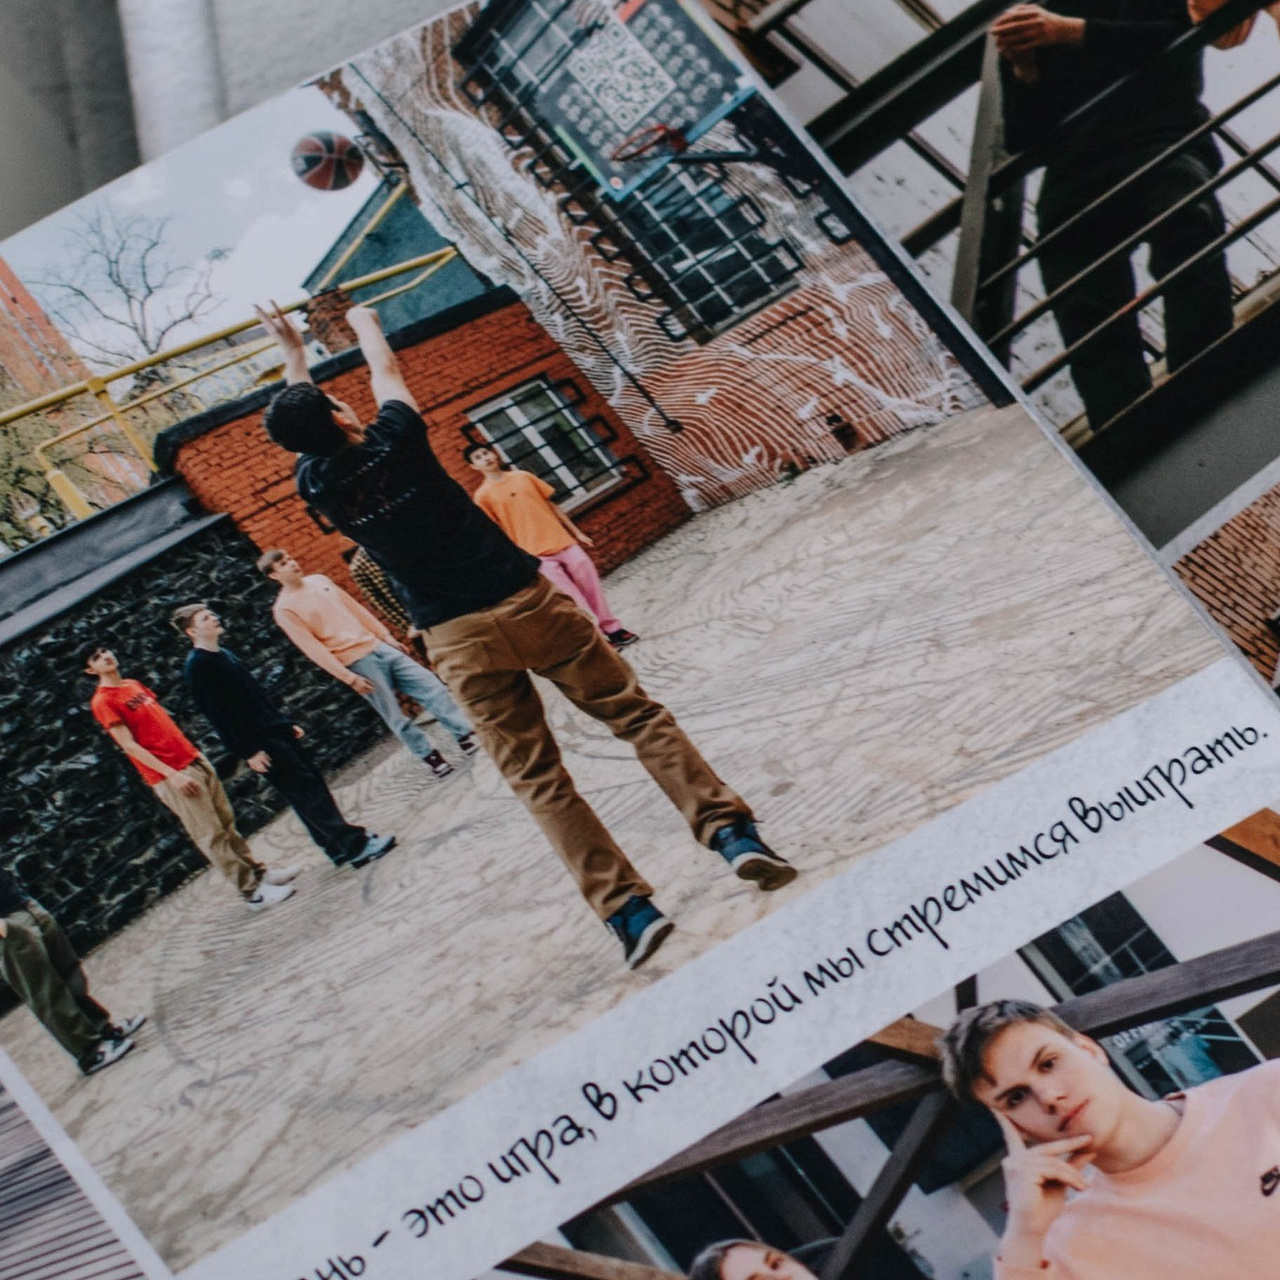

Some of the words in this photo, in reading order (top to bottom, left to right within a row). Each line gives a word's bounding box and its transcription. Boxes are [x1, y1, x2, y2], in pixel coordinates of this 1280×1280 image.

[401, 1174, 486, 1238] это
[487, 1114, 598, 1185] игра,
[582, 1081, 618, 1122] в
[622, 975, 803, 1103] которой
[803, 946, 865, 997] мы
[866, 820, 1080, 957] стремимся
[1067, 725, 1270, 834] выиграть.
